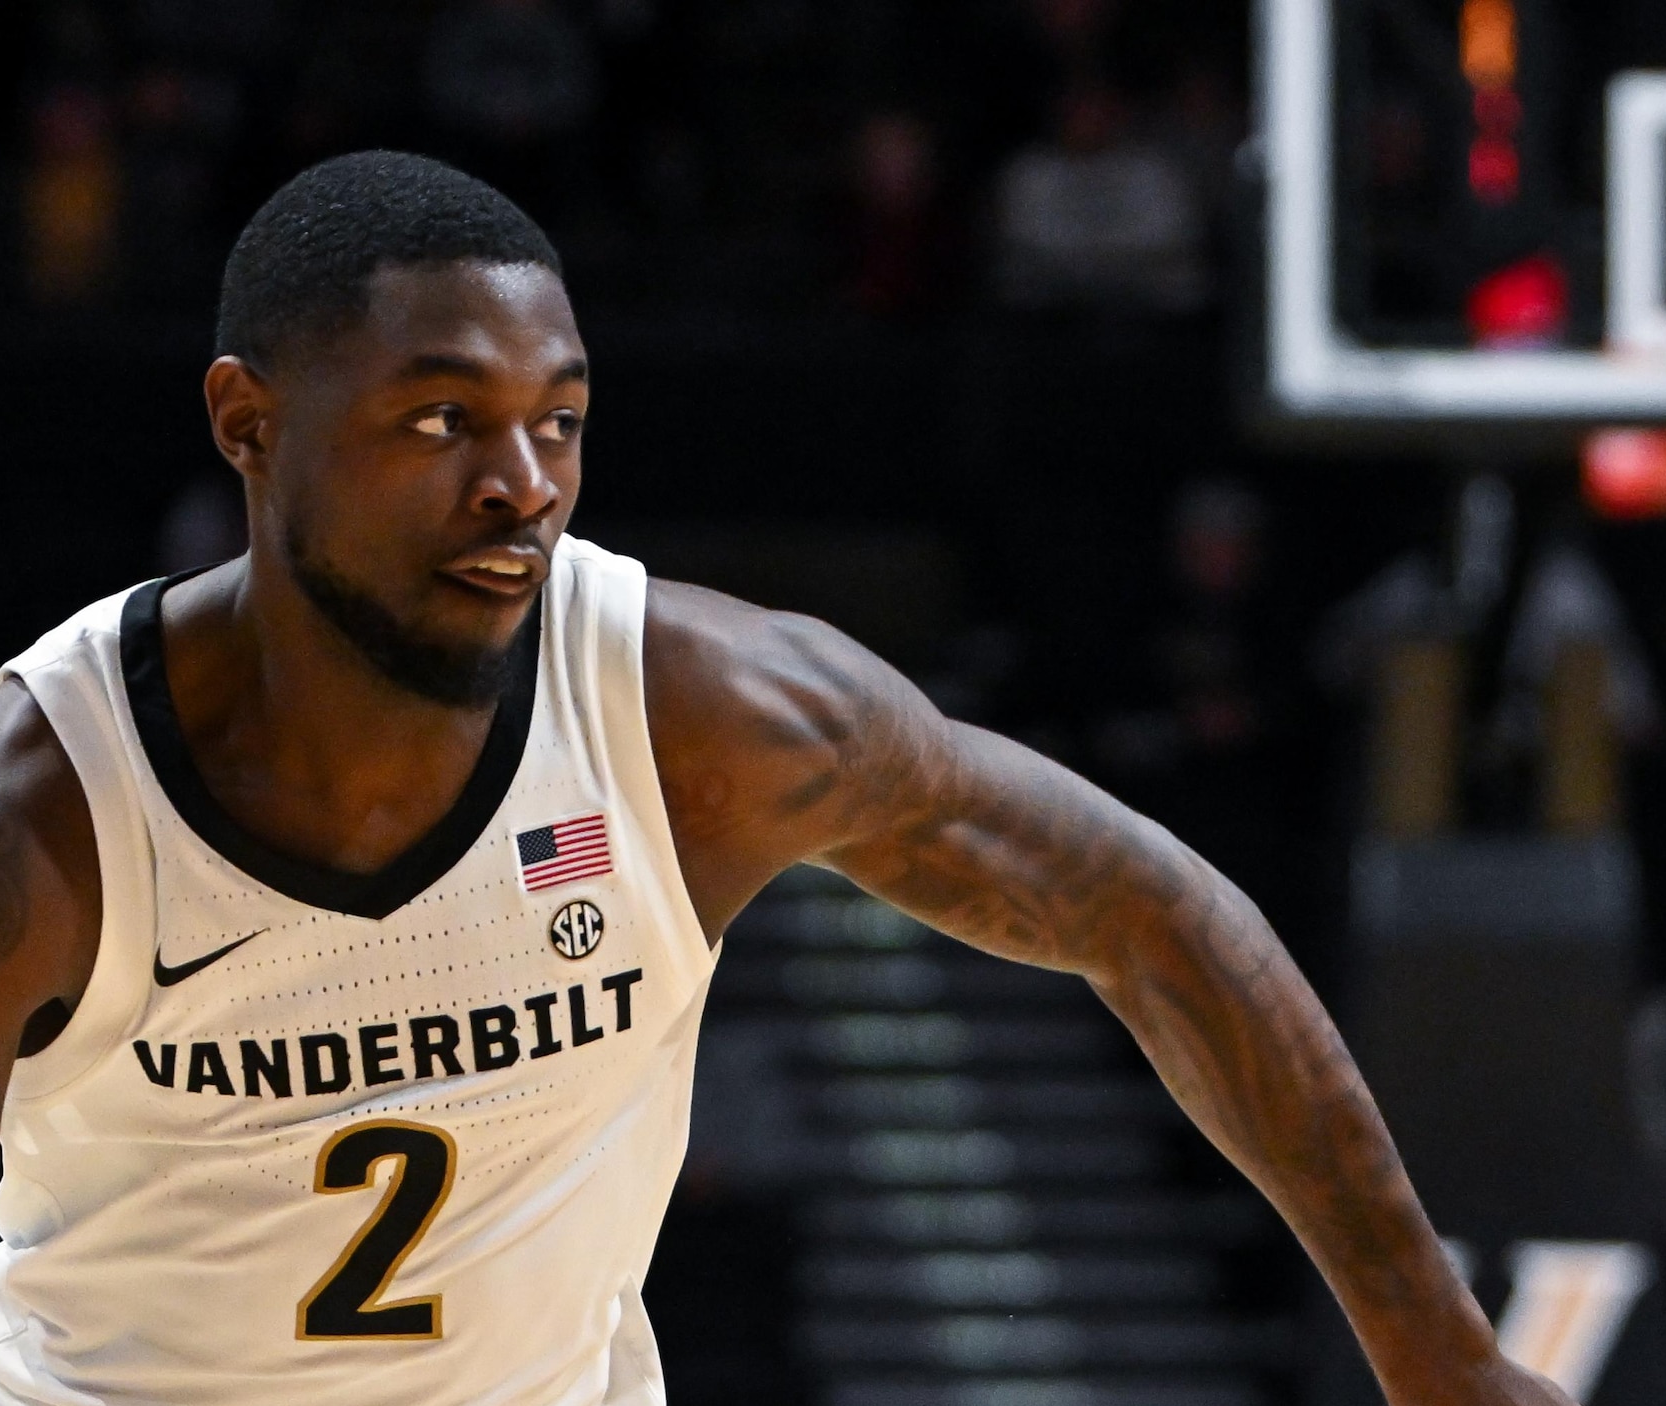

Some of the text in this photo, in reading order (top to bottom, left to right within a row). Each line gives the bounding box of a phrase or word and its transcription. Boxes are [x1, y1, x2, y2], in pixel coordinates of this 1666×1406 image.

[551, 901, 602, 958] SEC
[134, 967, 644, 1099] VANDERBILT
[294, 1118, 458, 1341] 2
